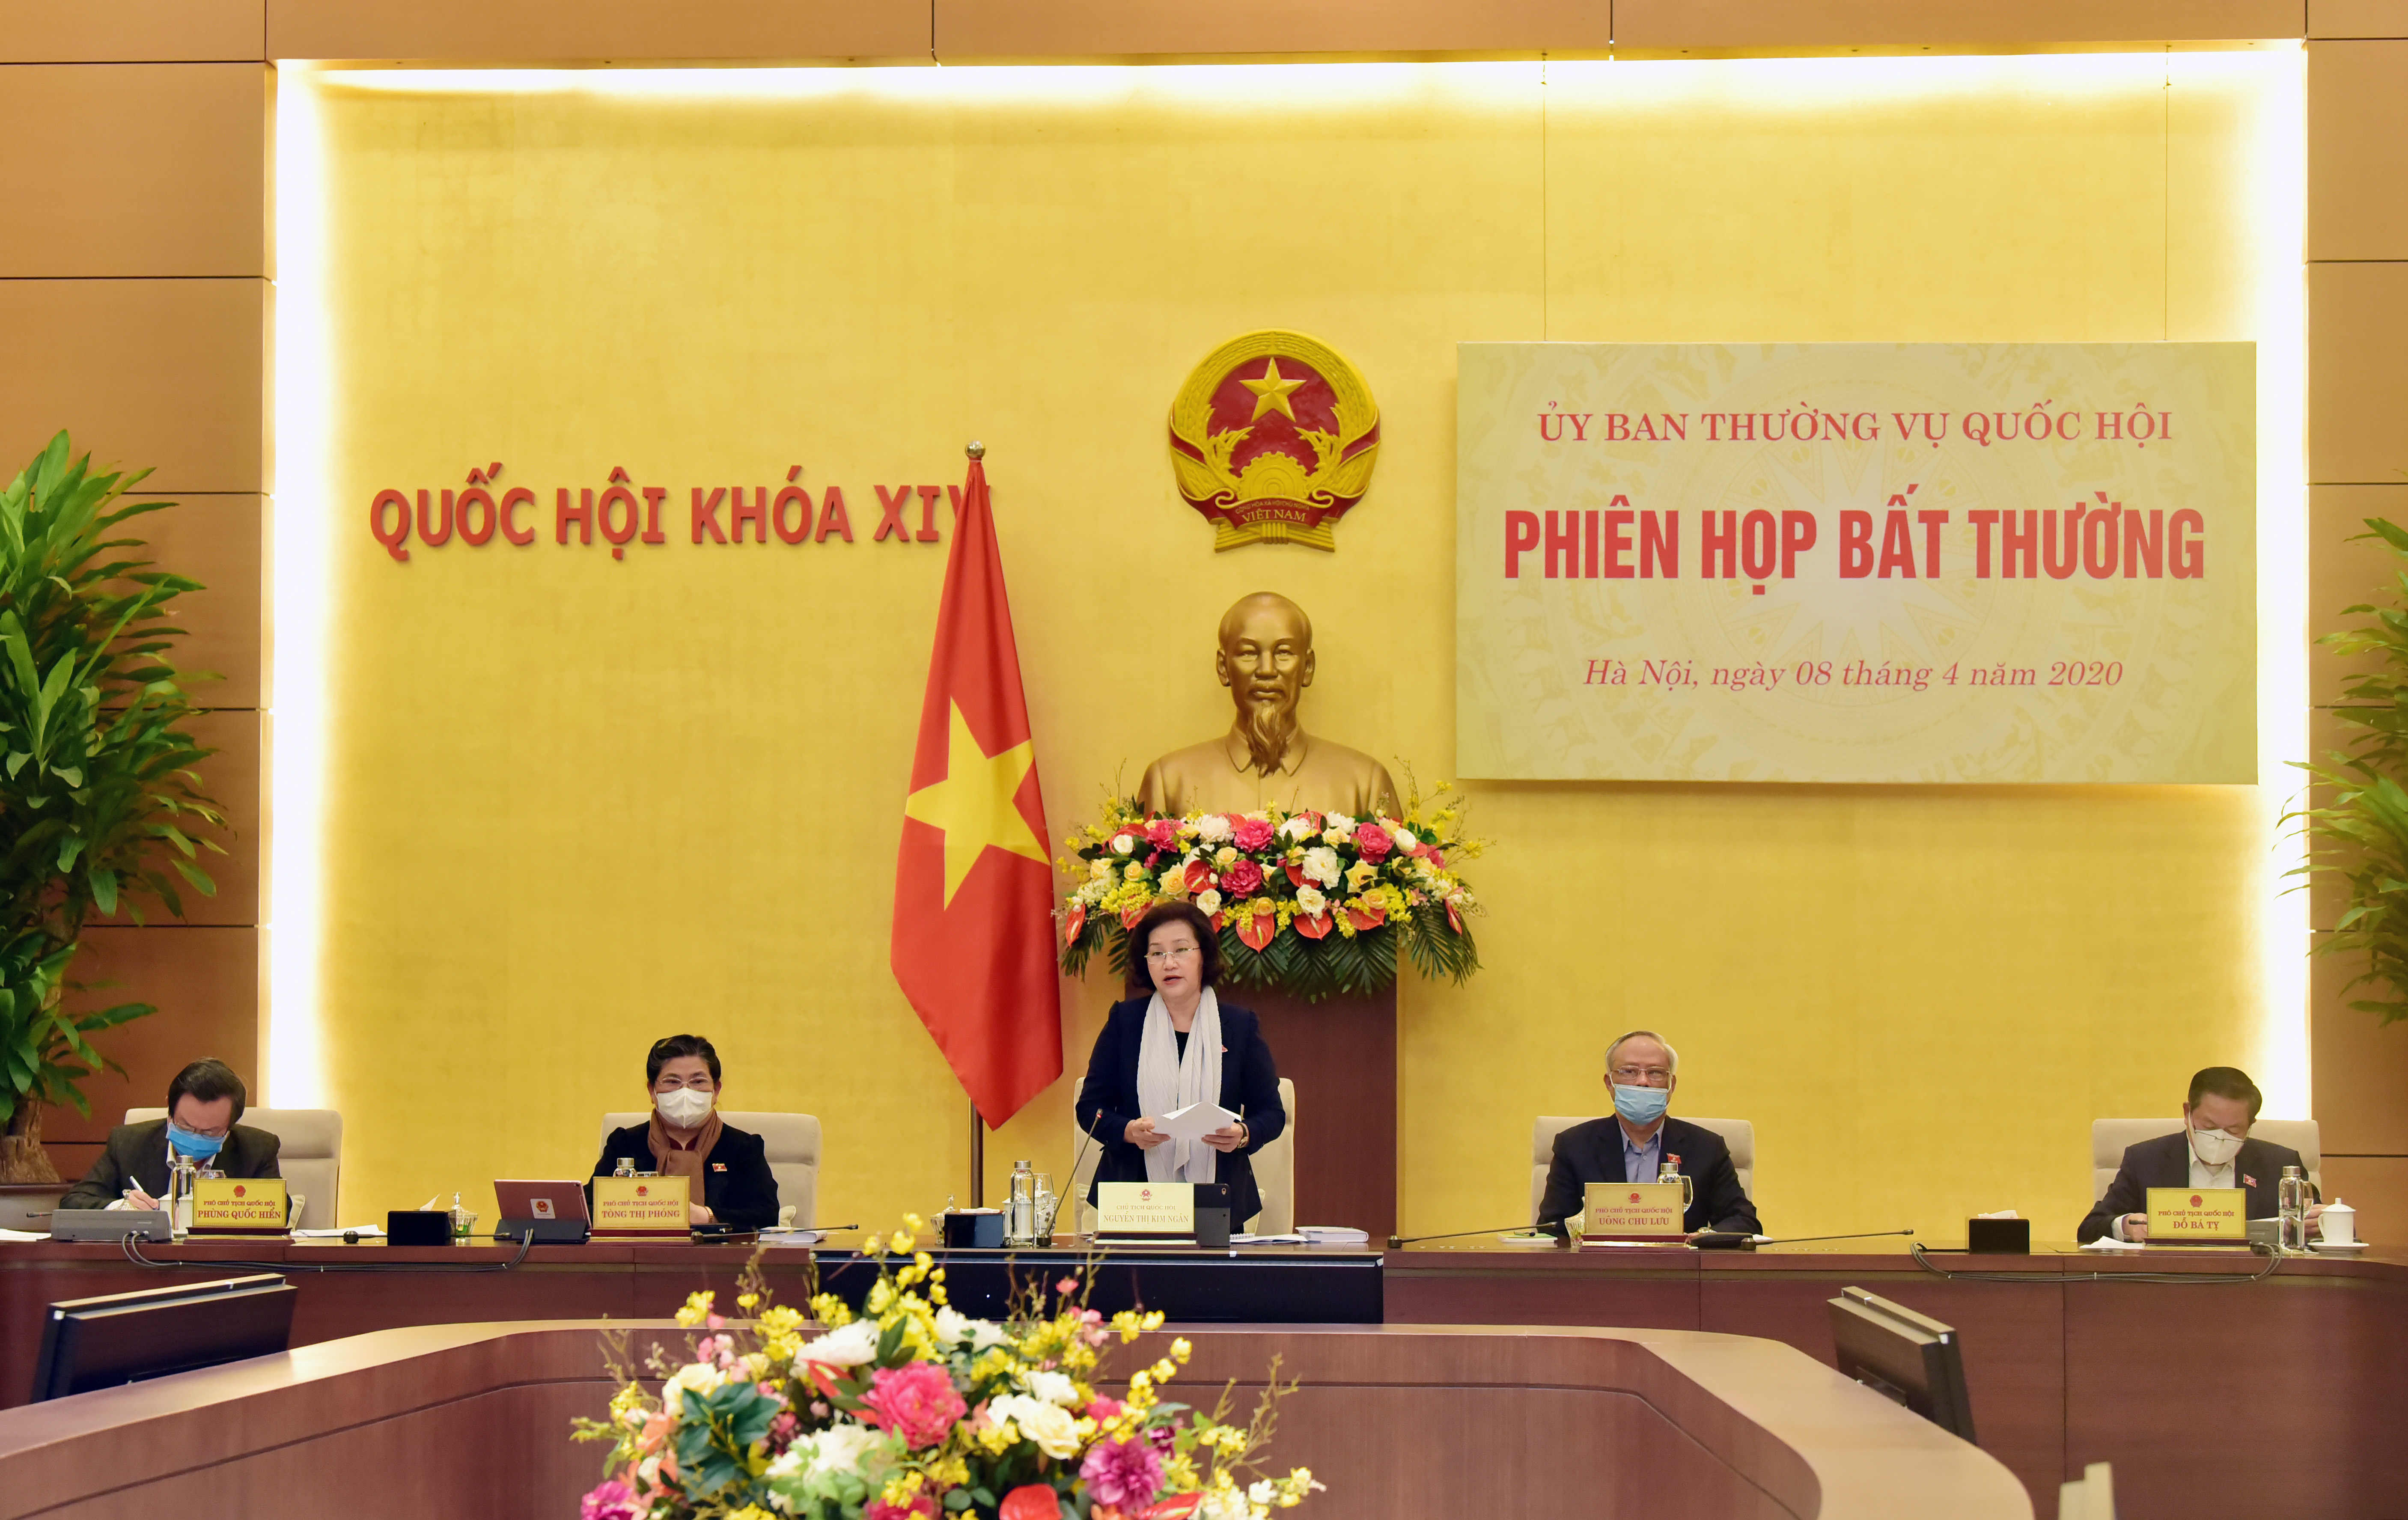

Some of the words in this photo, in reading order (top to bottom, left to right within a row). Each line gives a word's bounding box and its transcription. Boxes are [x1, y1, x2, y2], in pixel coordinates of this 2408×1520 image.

[1538, 401, 1592, 441] ỦY
[1605, 413, 1688, 441] BAN
[1701, 401, 1880, 441] THƯỜNG
[1892, 412, 1949, 449] VỤ
[1962, 399, 2081, 447] QUỐC
[2095, 402, 2172, 449] HỘI
[370, 462, 535, 562] QUỐC
[556, 466, 667, 560] HỘI
[691, 465, 854, 544] KHÓA
[1274, 509, 1306, 522] NAM
[1505, 495, 1679, 579] PHIÊN
[1701, 509, 1817, 595] HỌP
[1839, 484, 1949, 579] BẤT
[1968, 491, 2203, 580] THƯỜNG
[1584, 659, 1627, 685] Hà
[1639, 659, 1698, 691] Nội,
[1711, 660, 1786, 691] ngày
[1796, 661, 1833, 685] 08
[1843, 660, 1933, 691] tháng
[1942, 661, 1958, 685] 4
[1969, 663, 2036, 686] năm
[2048, 661, 2123, 686] 2020
[198, 1208, 229, 1218] PHÙNG
[231, 1208, 256, 1220] QUỐC
[259, 1207, 281, 1219] HIỂN
[602, 1208, 627, 1218] TÒNG
[629, 1210, 647, 1220] THỊ
[648, 1208, 680, 1218] PHÓNG
[1136, 1214, 1149, 1224] THỊ
[1599, 1215, 1625, 1225] UÔNG
[1650, 1217, 1670, 1225] LƯU
[2173, 1217, 2188, 1228] ĐỖ
[2191, 1219, 2204, 1229] BÁ
